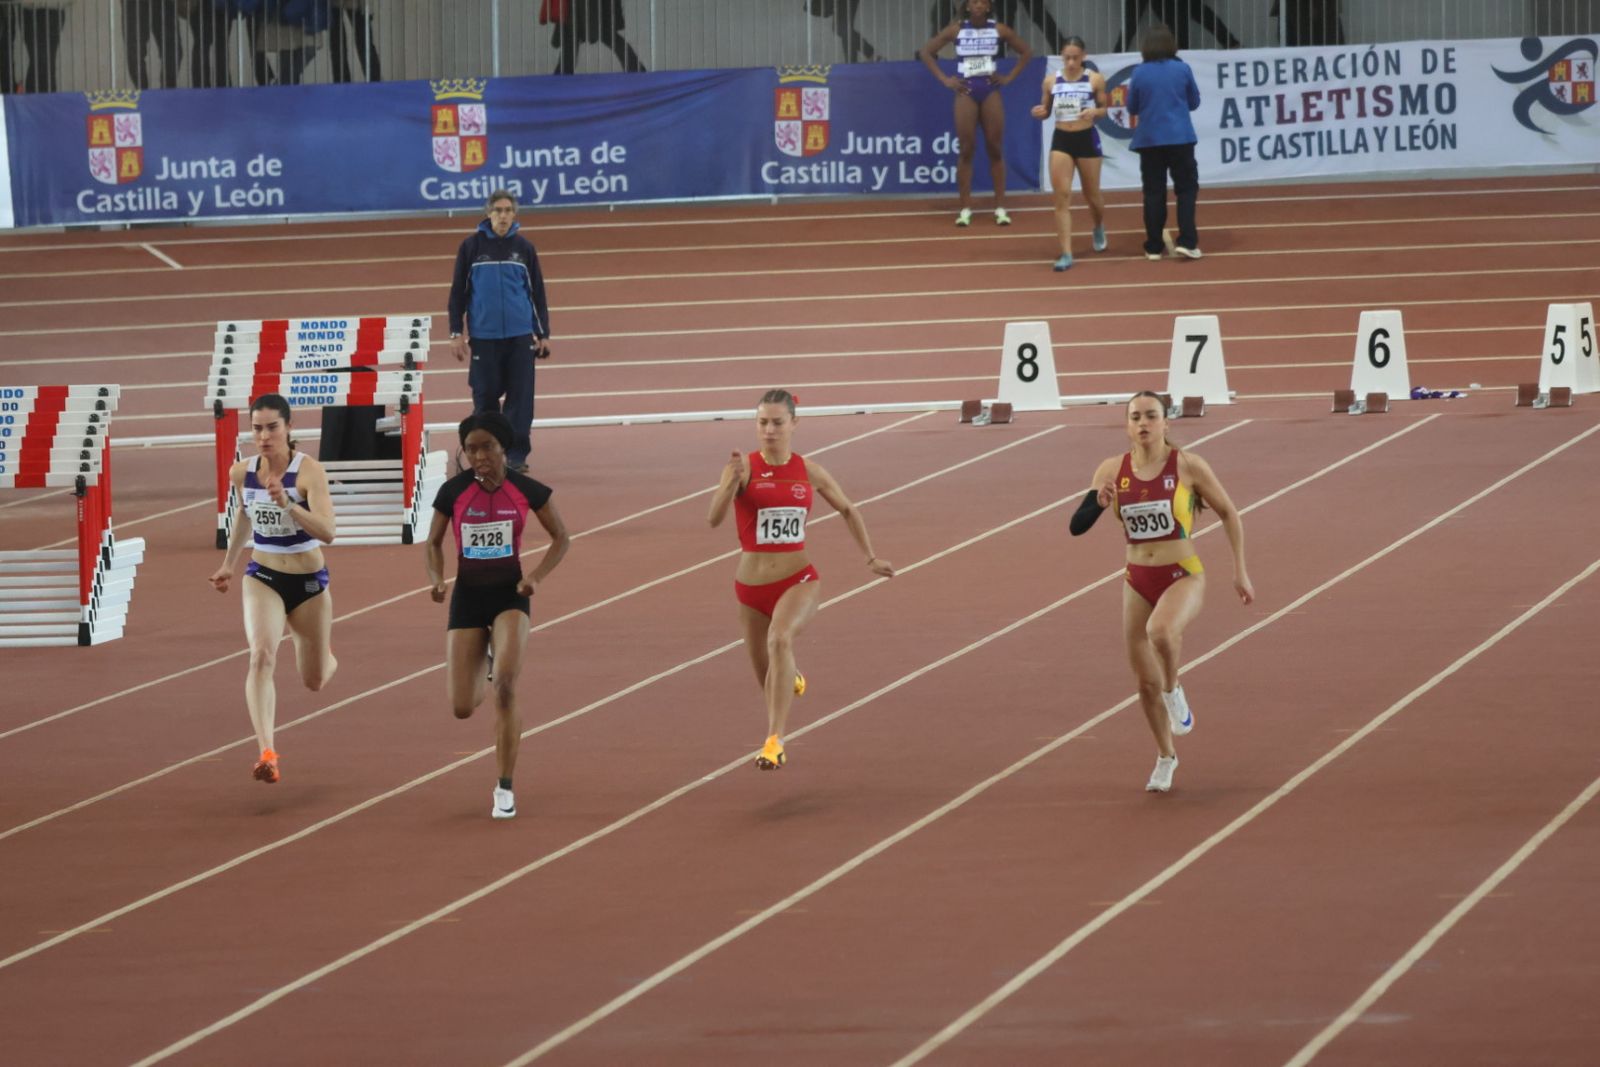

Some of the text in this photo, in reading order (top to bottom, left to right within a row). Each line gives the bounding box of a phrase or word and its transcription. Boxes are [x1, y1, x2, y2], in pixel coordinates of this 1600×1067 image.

[1217, 44, 1457, 89] FEDERACIÓN DE
[1219, 82, 1458, 129] ATLETISMO
[499, 141, 626, 169] Junta de
[840, 129, 961, 156] Junta de
[1220, 118, 1458, 164] DE CASTILLA Y LEÓN
[155, 153, 282, 181] Junta de
[761, 159, 863, 185] Castilla
[872, 165, 888, 190] y
[76, 181, 285, 216] Castilla y León
[420, 167, 628, 204] Castilla y León
[298, 331, 345, 341] MONDO
[301, 320, 347, 330] MONDO
[1580, 316, 1592, 358] 5
[300, 344, 343, 353] MONDO
[1185, 333, 1209, 374] 7
[1368, 327, 1391, 369] 6
[1550, 324, 1566, 365] 5
[295, 358, 337, 369] MONDO
[1015, 342, 1040, 384] 8
[290, 385, 337, 394] MONDO
[292, 374, 339, 384] MONDO
[288, 396, 335, 406] MONDO
[255, 510, 282, 526] 2597
[761, 518, 800, 539] 1540
[1127, 512, 1169, 533] 3930
[470, 531, 503, 547] 2128
